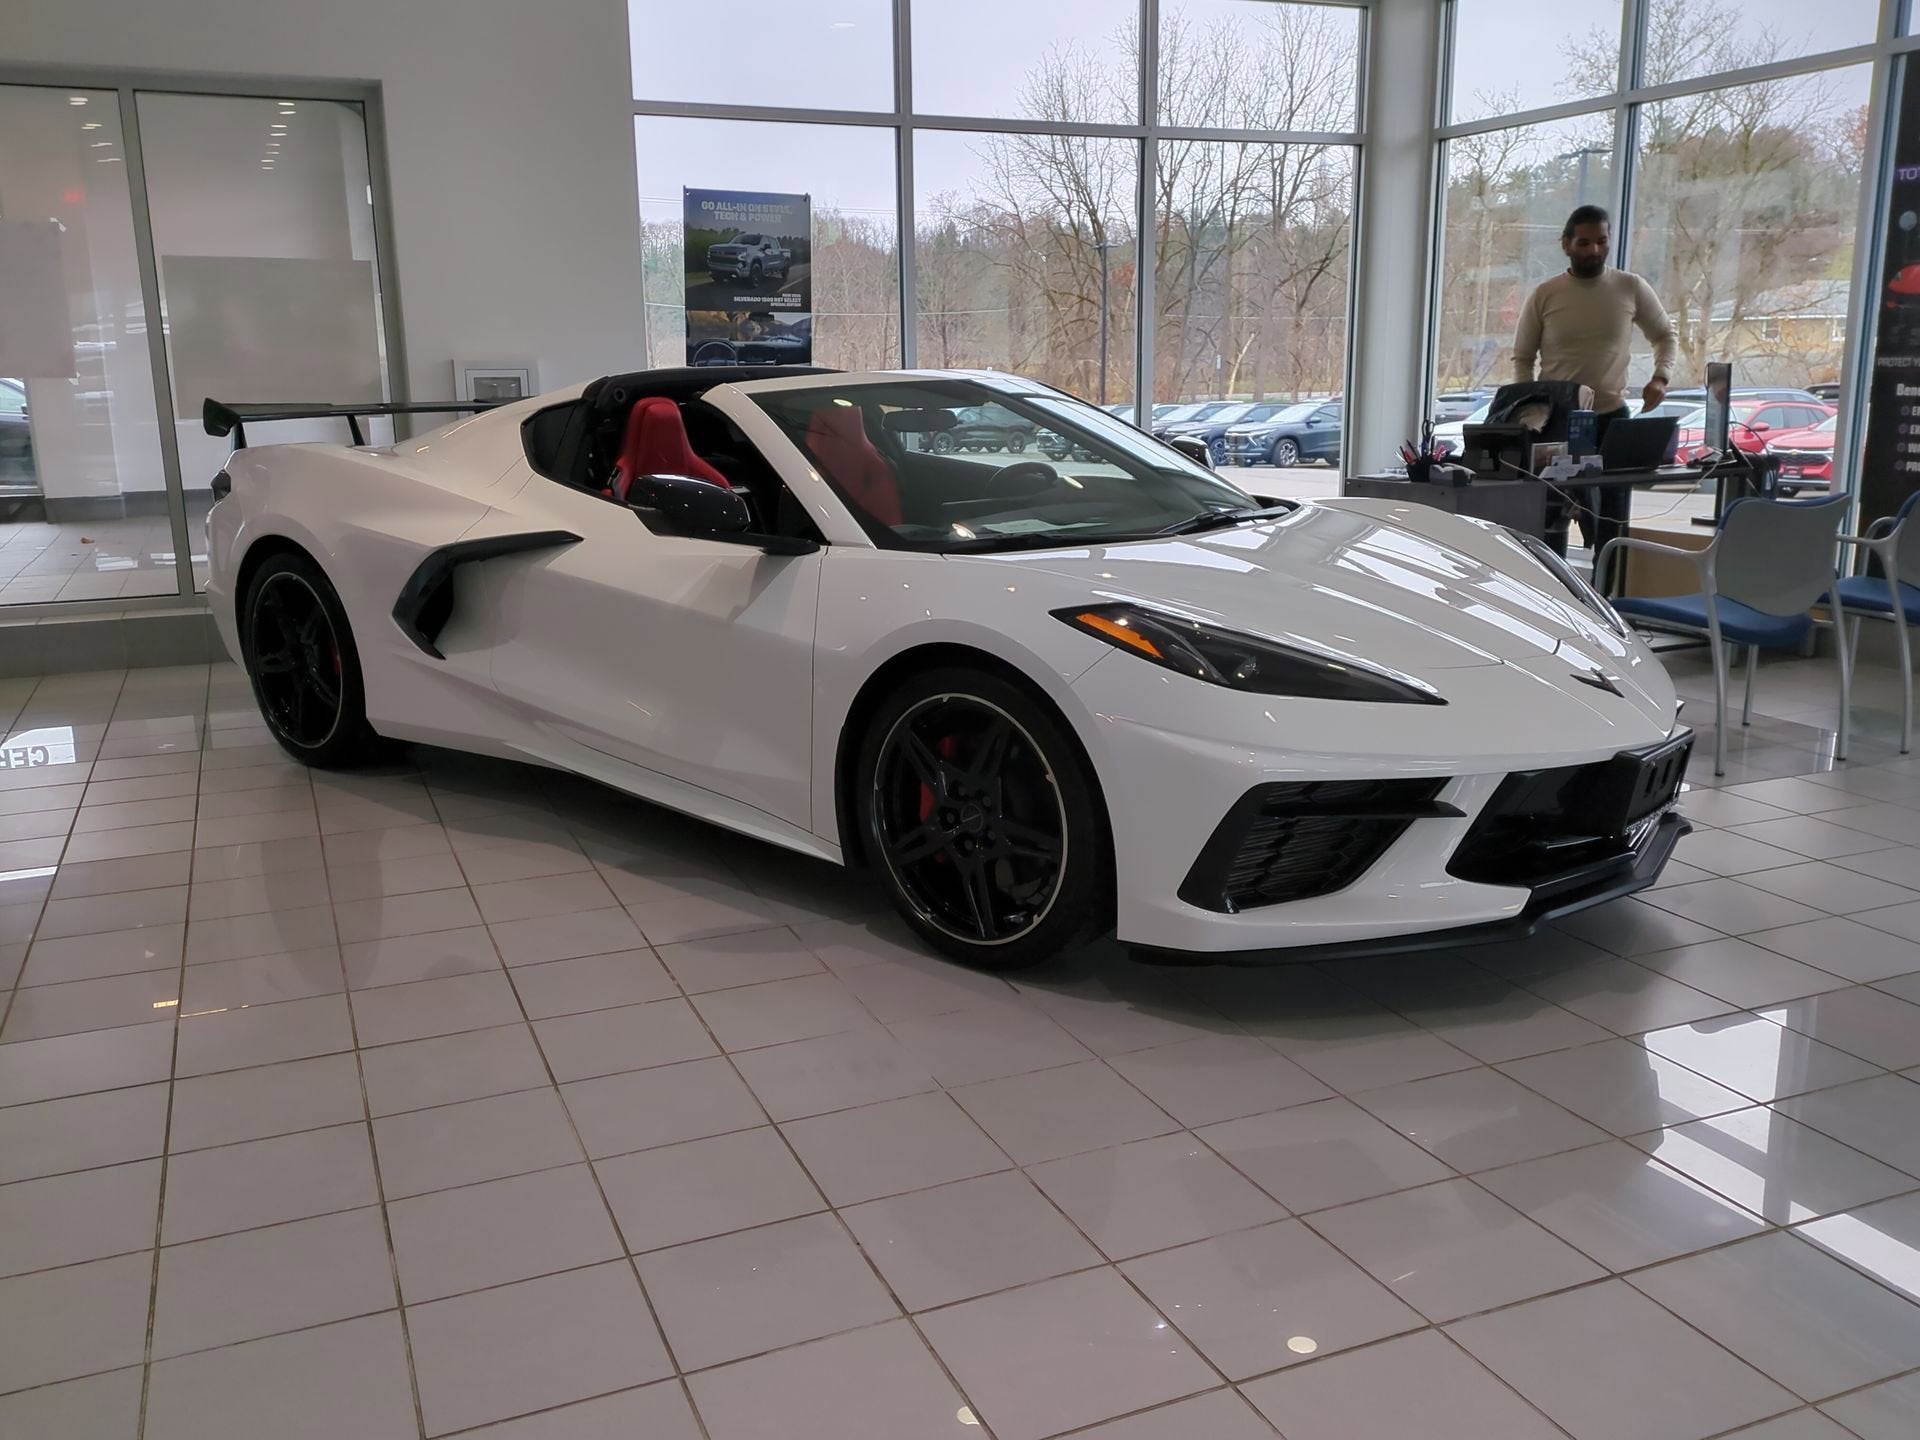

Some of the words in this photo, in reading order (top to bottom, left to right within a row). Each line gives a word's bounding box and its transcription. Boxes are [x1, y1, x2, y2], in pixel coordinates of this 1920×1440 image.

[1899, 166, 1920, 181] TO
[701, 201, 715, 210] GO
[716, 202, 747, 212] ALL-IN
[714, 211, 738, 221] TECH
